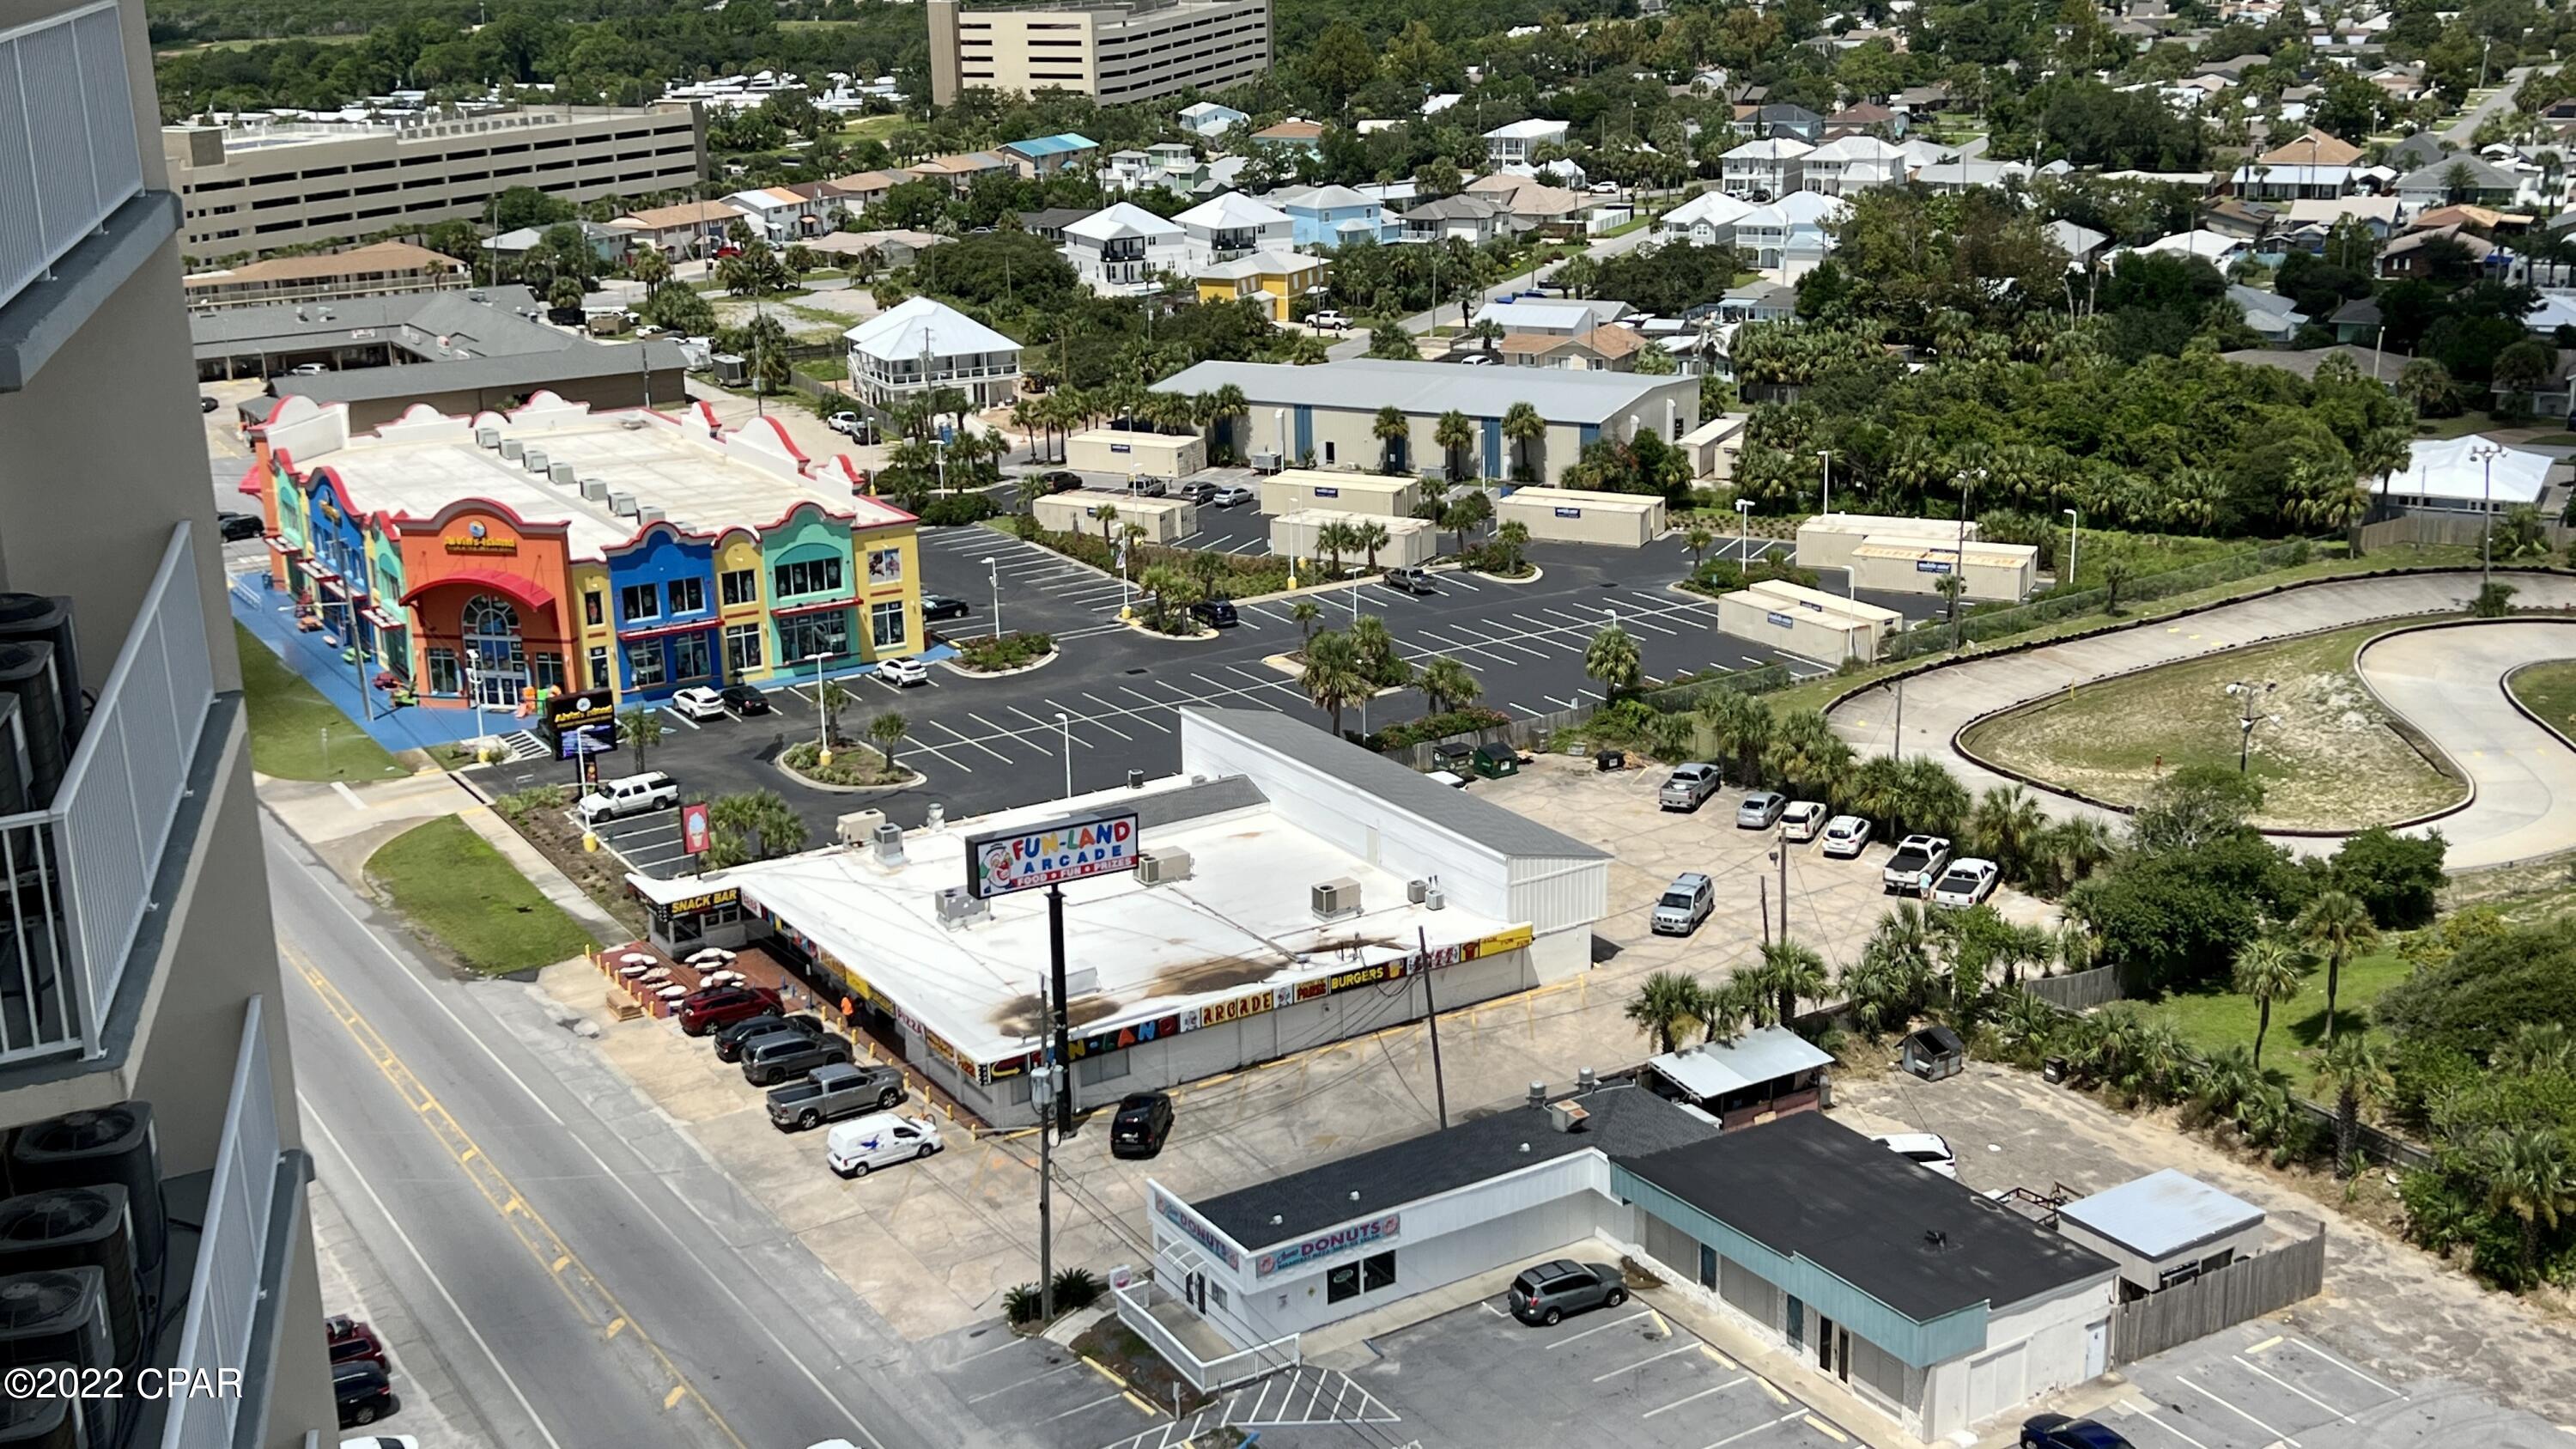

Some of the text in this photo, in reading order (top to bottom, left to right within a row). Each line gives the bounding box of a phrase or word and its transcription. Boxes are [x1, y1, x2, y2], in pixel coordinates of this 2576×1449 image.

[1012, 821, 1131, 861] FUN-LAND
[1017, 856, 1133, 886] FOOD FUN PRIZES
[1024, 845, 1122, 874] ARCADE
[671, 894, 713, 914] SNACK
[714, 889, 738, 904] BAR
[1331, 967, 1384, 990] BURGERS
[1203, 991, 1273, 1025] ARCADE
[1180, 1212, 1227, 1256] DONUTS
[1301, 1221, 1381, 1257] DONUTS
